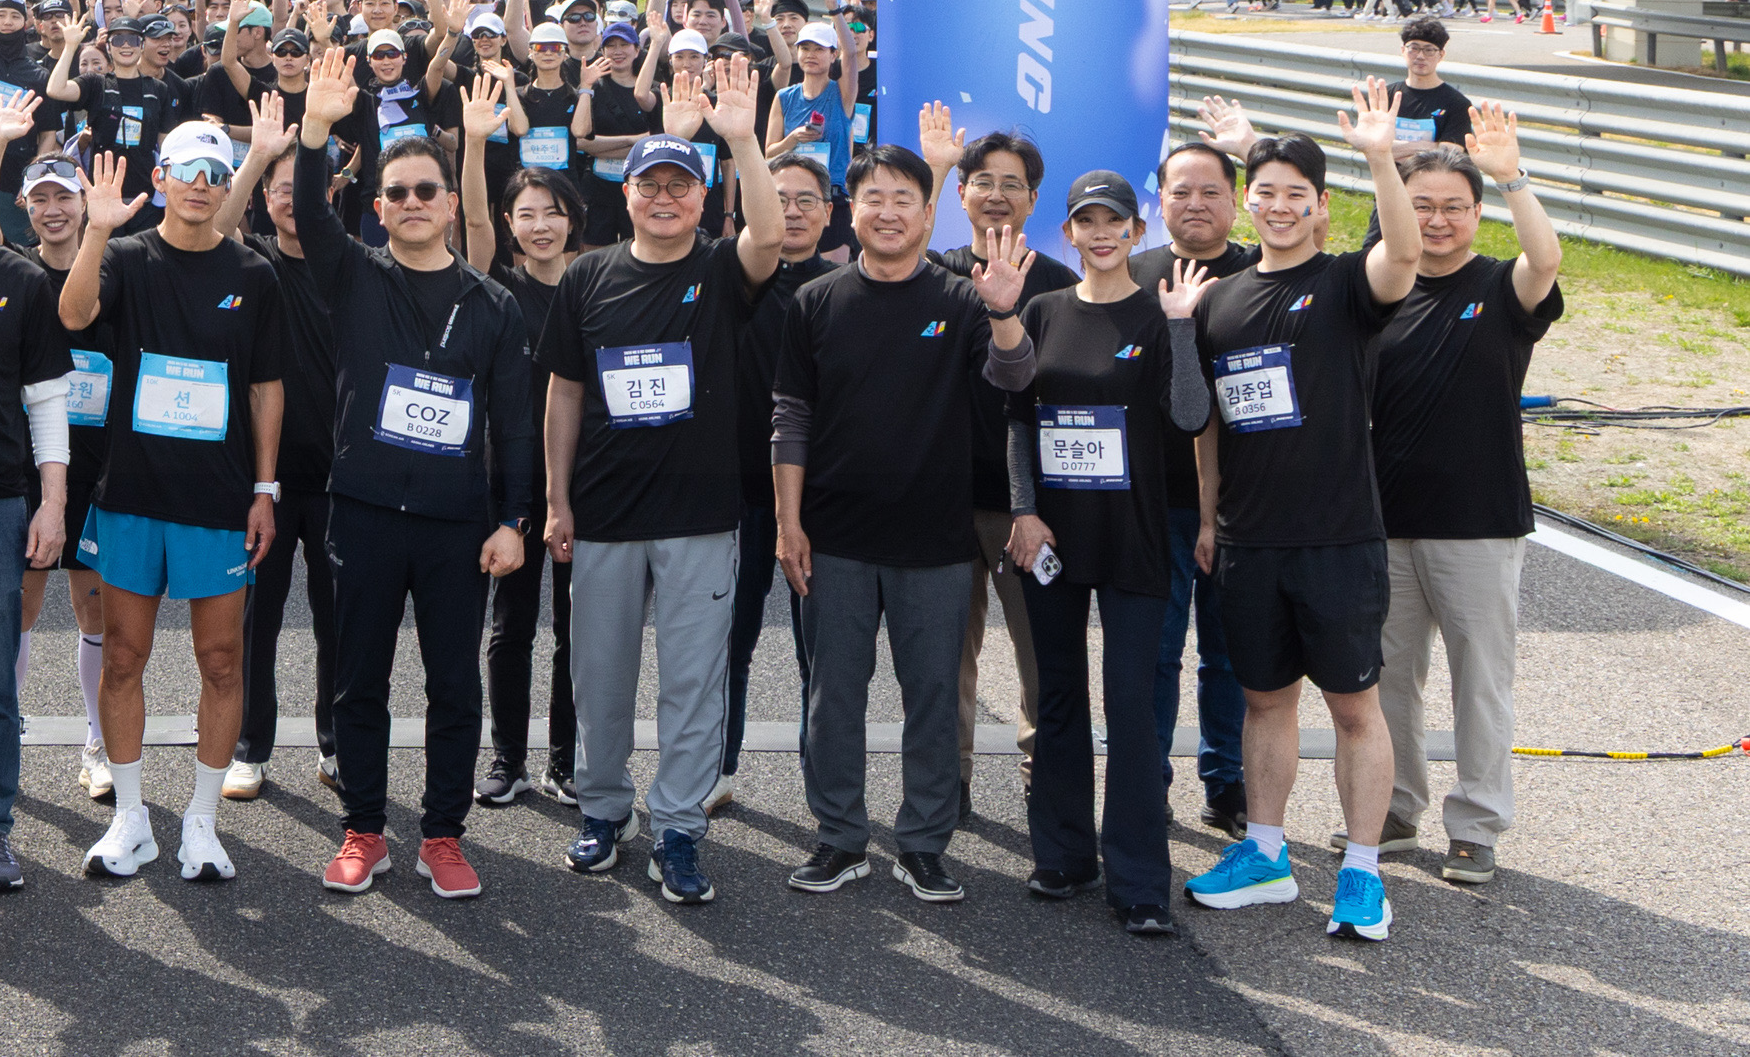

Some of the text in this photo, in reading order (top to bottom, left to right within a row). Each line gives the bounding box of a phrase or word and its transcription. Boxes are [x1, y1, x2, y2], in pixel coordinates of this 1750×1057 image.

[642, 141, 691, 158] SRIXON
[624, 353, 663, 366] WE RUN
[1227, 356, 1263, 372] WE RUN
[166, 365, 182, 376] WE
[414, 377, 431, 391] WE
[431, 381, 454, 396] RUN
[626, 377, 666, 398] 김 진
[1226, 379, 1273, 405] 김준엽
[174, 390, 190, 410] 션
[630, 400, 665, 410] C 0564
[406, 403, 451, 426] COZ
[1242, 403, 1266, 414] 0356
[163, 411, 199, 422] A 1004
[1058, 415, 1095, 426] WE RUN
[407, 423, 442, 438] B 0228
[1053, 440, 1105, 460] 문슬아
[1062, 462, 1096, 471] D 0777
